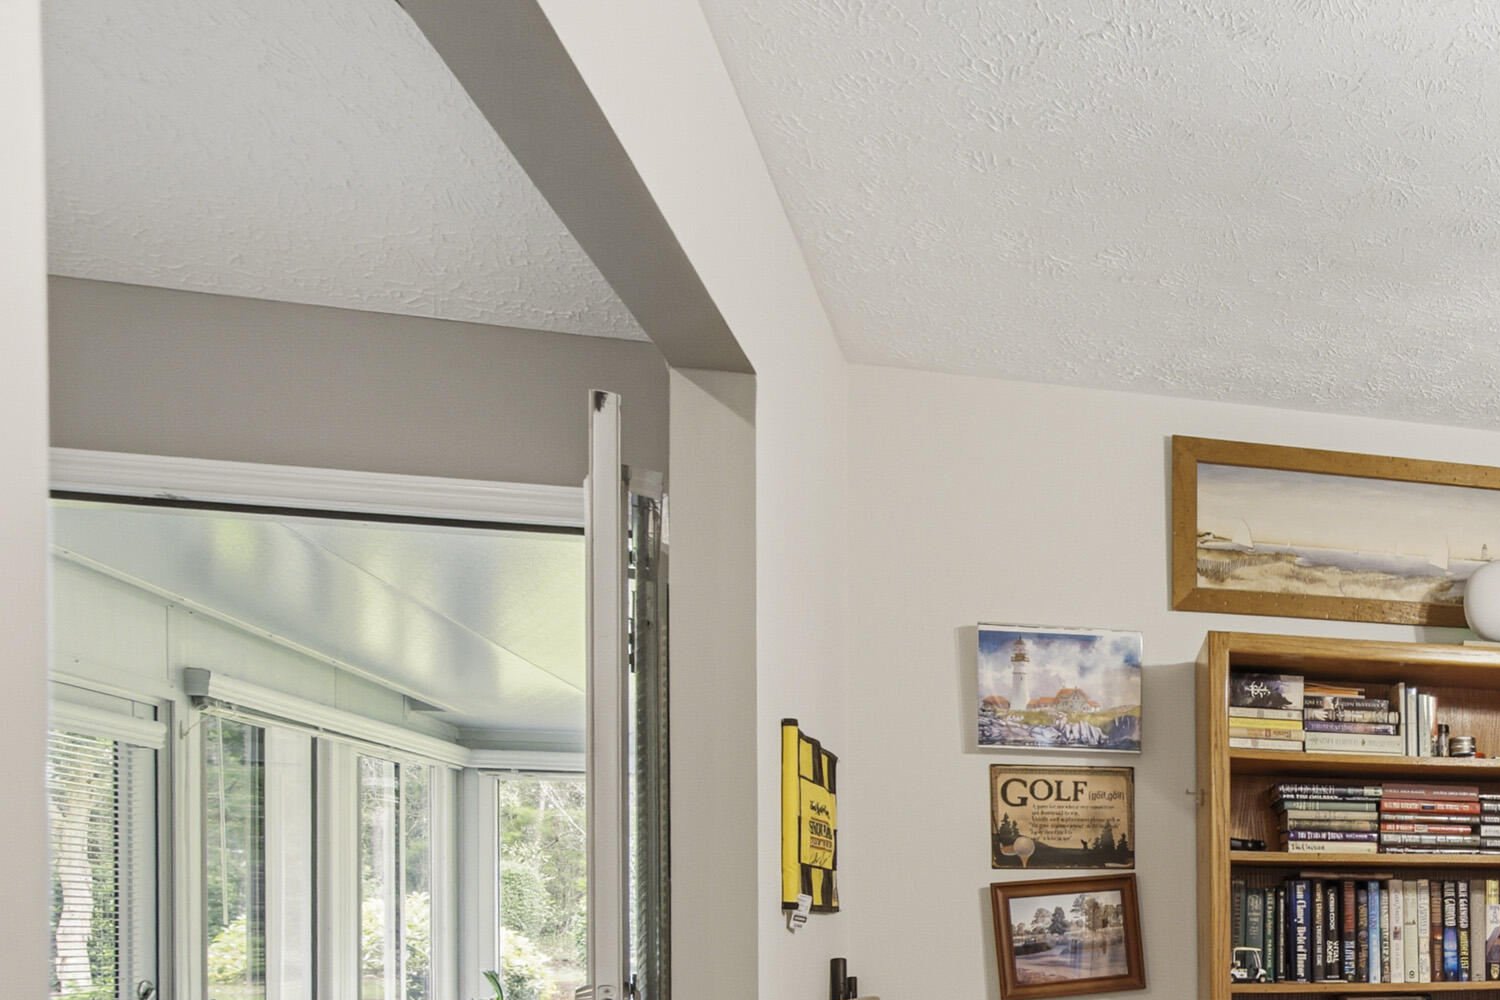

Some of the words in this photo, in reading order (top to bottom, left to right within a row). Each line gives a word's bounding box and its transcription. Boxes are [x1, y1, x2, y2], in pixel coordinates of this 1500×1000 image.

[1001, 778, 1087, 807] GOLF
[1296, 884, 1306, 899] Tom
[1294, 900, 1307, 924] Clancy
[1296, 926, 1307, 945] Debt
[1296, 953, 1307, 977] Honor
